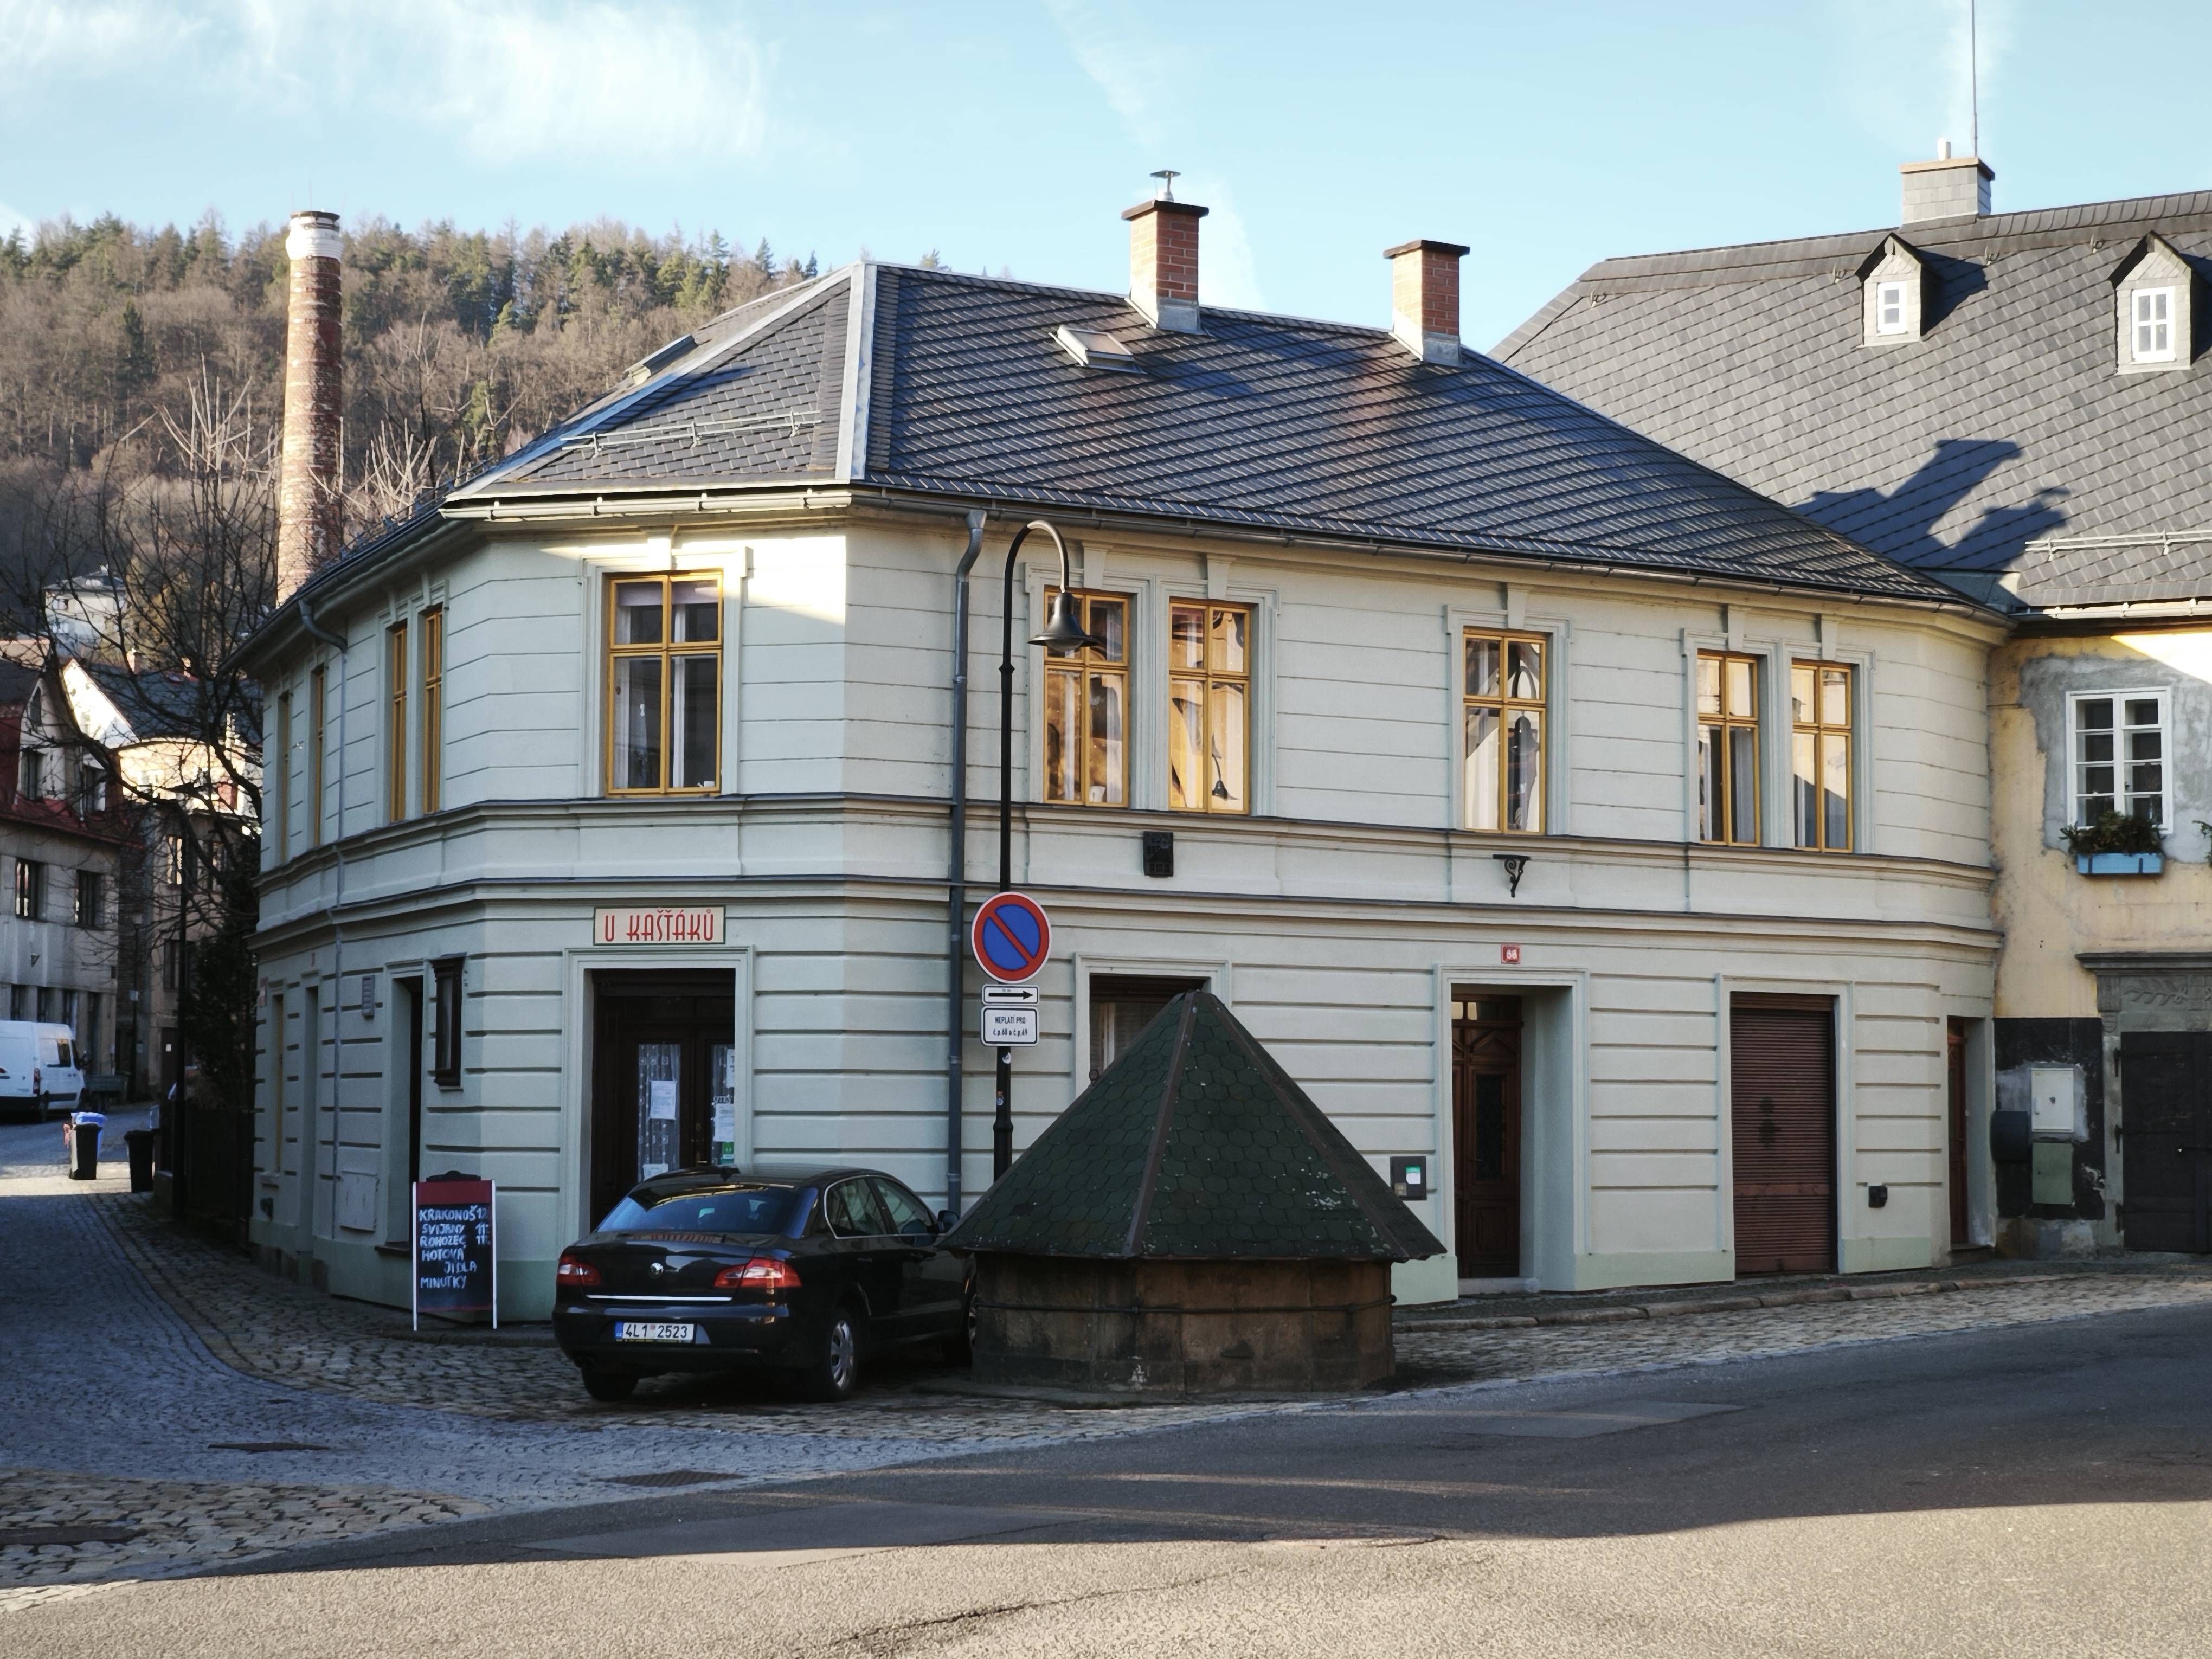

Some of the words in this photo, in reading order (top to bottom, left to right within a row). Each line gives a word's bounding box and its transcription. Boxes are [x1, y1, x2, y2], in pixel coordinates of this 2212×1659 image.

[605, 915, 615, 942] U
[626, 909, 714, 942] KAŠŤÁKŮ
[1506, 949, 1517, 960] 68
[995, 1015, 1015, 1024] NEPLATÍ
[1016, 1016, 1026, 1024] PRO
[419, 1205, 478, 1221] KRAKONOŠ
[422, 1223, 465, 1235] SVIJANY
[420, 1234, 466, 1247] ROHOZEC
[422, 1245, 466, 1261] HOTOVÁ
[420, 1275, 467, 1289] MINUTKY
[626, 1324, 648, 1338] 4L1
[657, 1325, 688, 1339] 2523
